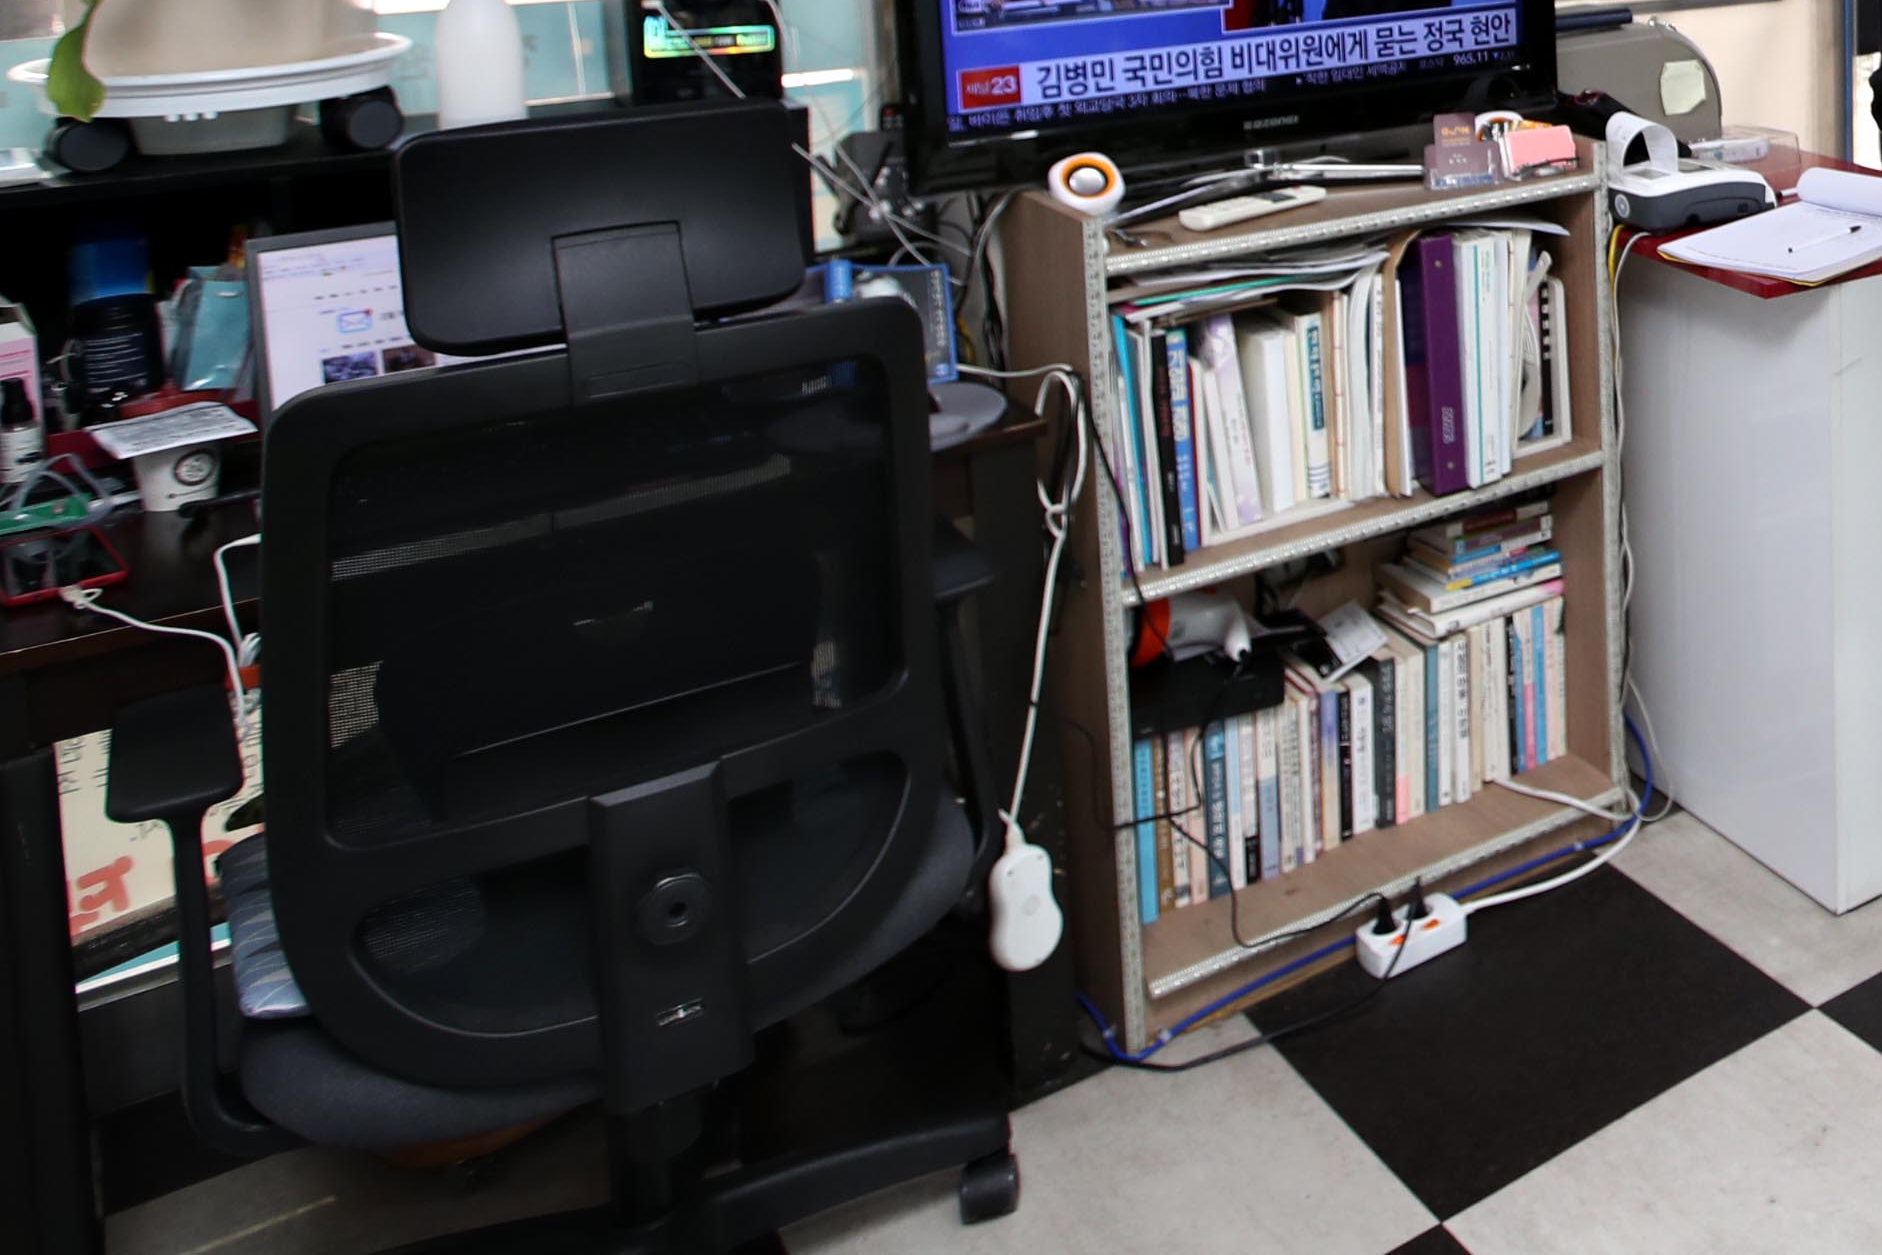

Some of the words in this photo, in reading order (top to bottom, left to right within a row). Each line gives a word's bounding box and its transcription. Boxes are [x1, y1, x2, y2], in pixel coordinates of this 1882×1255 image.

[1036, 58, 1115, 99] 김병민
[1122, 46, 1223, 88] 국민의힘
[1231, 29, 1368, 74] 비대위원에게
[1374, 25, 1418, 57] 묻는
[1424, 18, 1465, 50] 정국
[1470, 13, 1511, 46] 현안
[1454, 51, 1489, 66] 965.11
[990, 74, 1017, 94] 23
